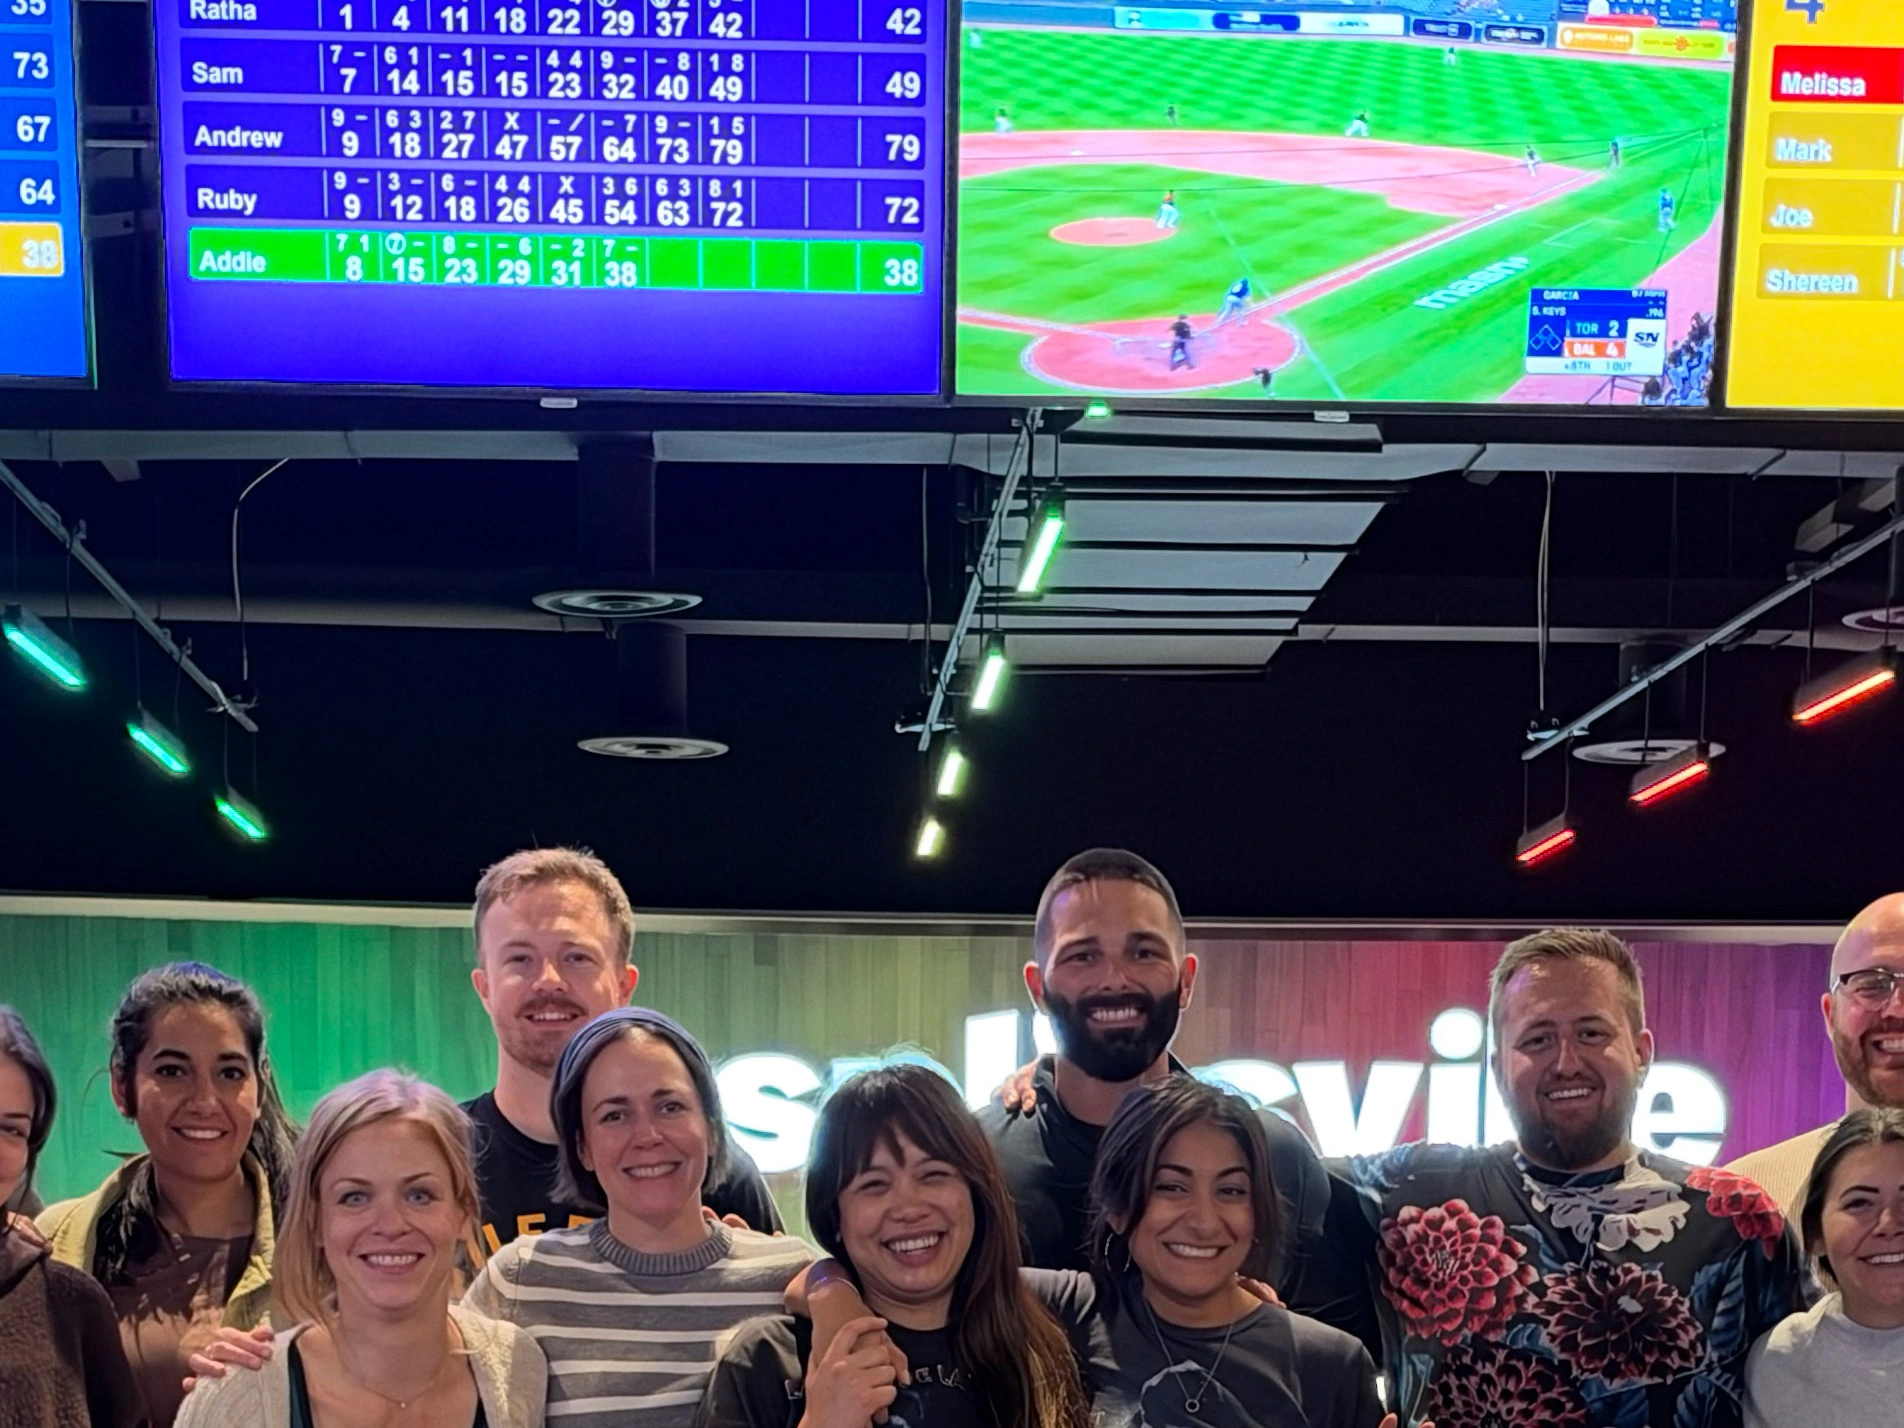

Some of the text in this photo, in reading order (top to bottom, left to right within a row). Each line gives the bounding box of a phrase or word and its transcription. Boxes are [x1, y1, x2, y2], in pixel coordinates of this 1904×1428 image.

[190, 0, 921, 34] Ratha 42
[14, 52, 48, 78] 73
[193, 62, 920, 101] Sam 7 14 15 15 23 32 40 49 49
[1781, 72, 1865, 96] Melissa
[17, 116, 50, 142] 67
[195, 125, 920, 164] Andrew 9 18 27 47 57 64 73 79 79
[1775, 138, 1833, 162] Mark
[20, 178, 55, 204] 64
[198, 188, 919, 226] Ruby 9 12 18 26 45 54 63 72 72
[1770, 206, 1813, 229] Joe
[22, 239, 58, 268] 38
[200, 250, 918, 287] Addie 8 15 23 29 31 38 38
[1767, 271, 1858, 294] Shereen
[1576, 320, 1619, 336] TOR 2
[1606, 343, 1618, 356] 4
